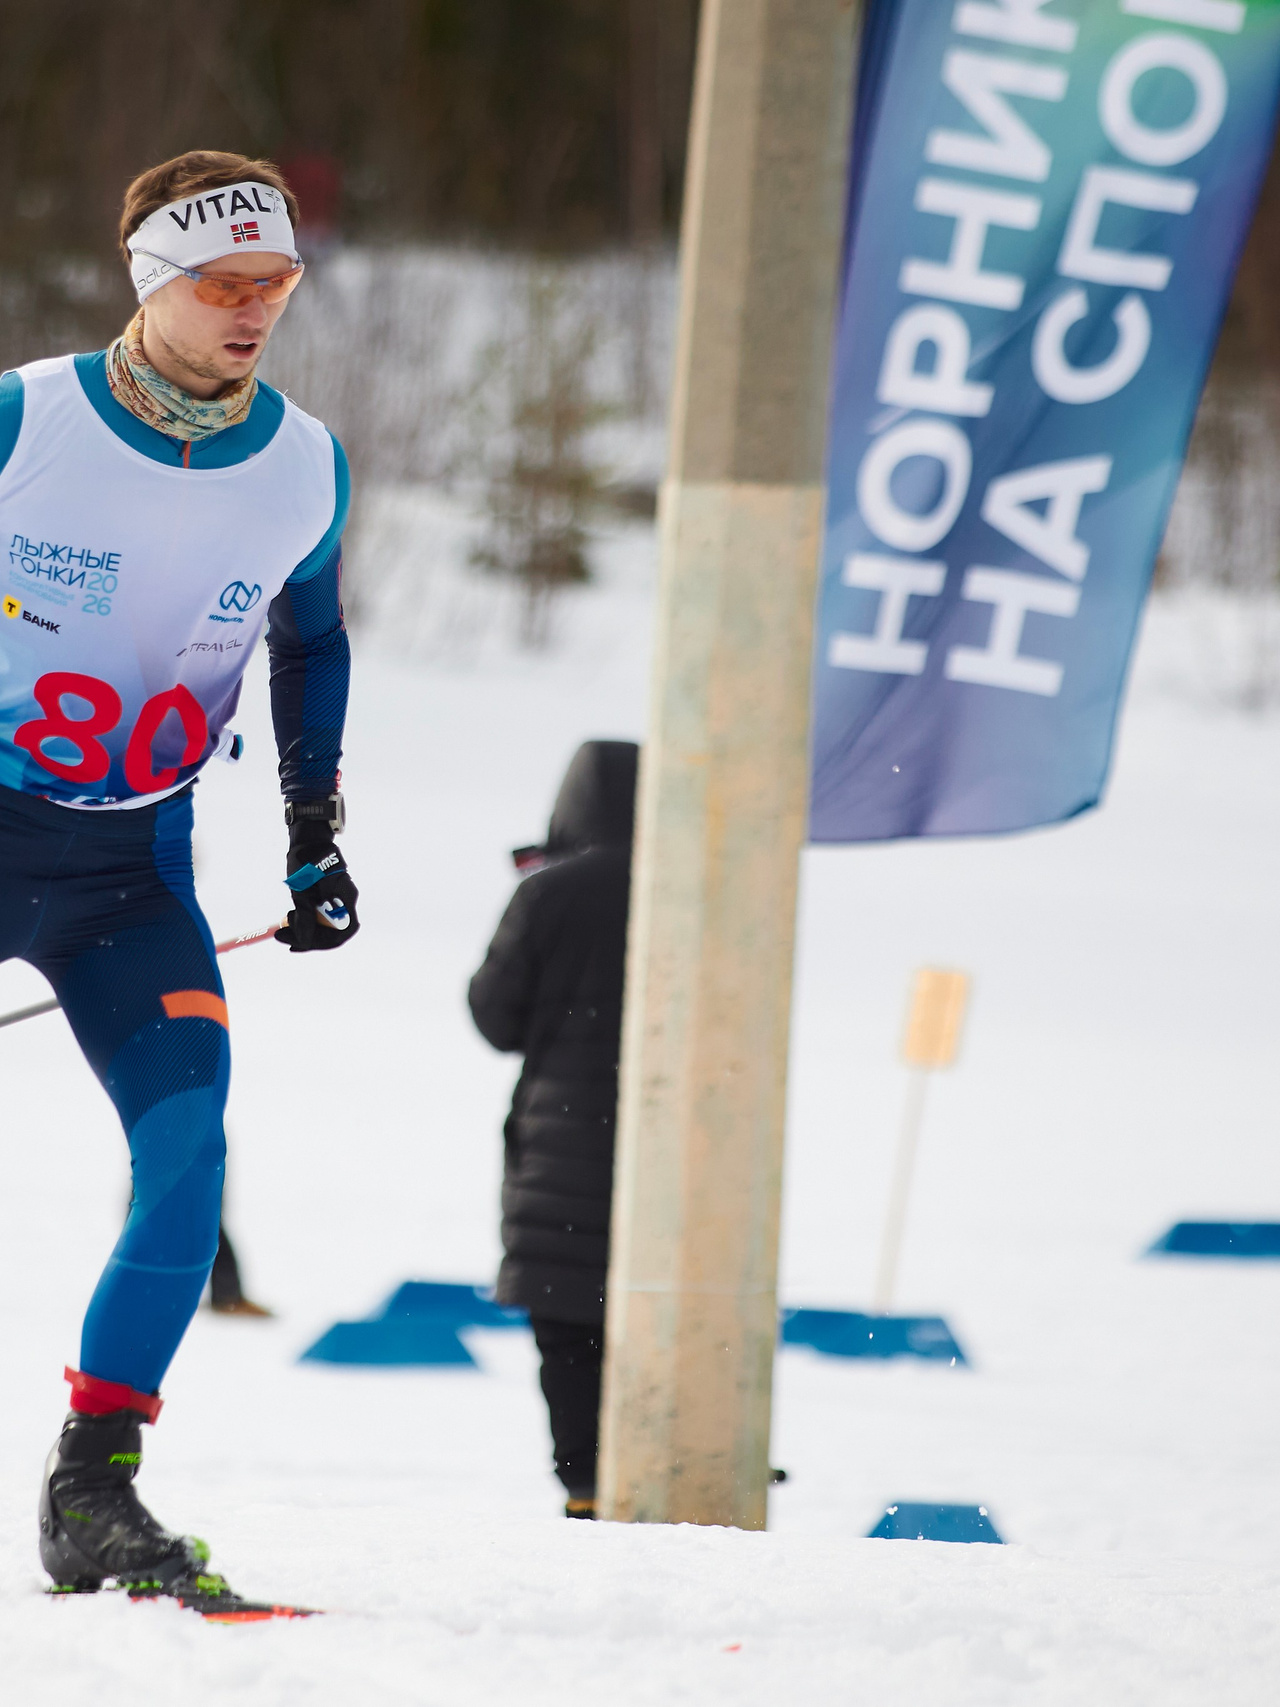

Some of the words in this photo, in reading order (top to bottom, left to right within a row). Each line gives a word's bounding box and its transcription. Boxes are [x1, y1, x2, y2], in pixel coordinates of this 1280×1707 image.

[168, 187, 272, 232] VITAL
[8, 551, 87, 589] ГОНКИ
[86, 571, 118, 594] 20
[10, 534, 122, 572] ЛЫЖНЫЕ
[943, 454, 1113, 698] НА
[22, 610, 61, 634] БАНК
[81, 594, 112, 616] 26
[14, 671, 208, 794] 80
[315, 853, 340, 872] SWI
